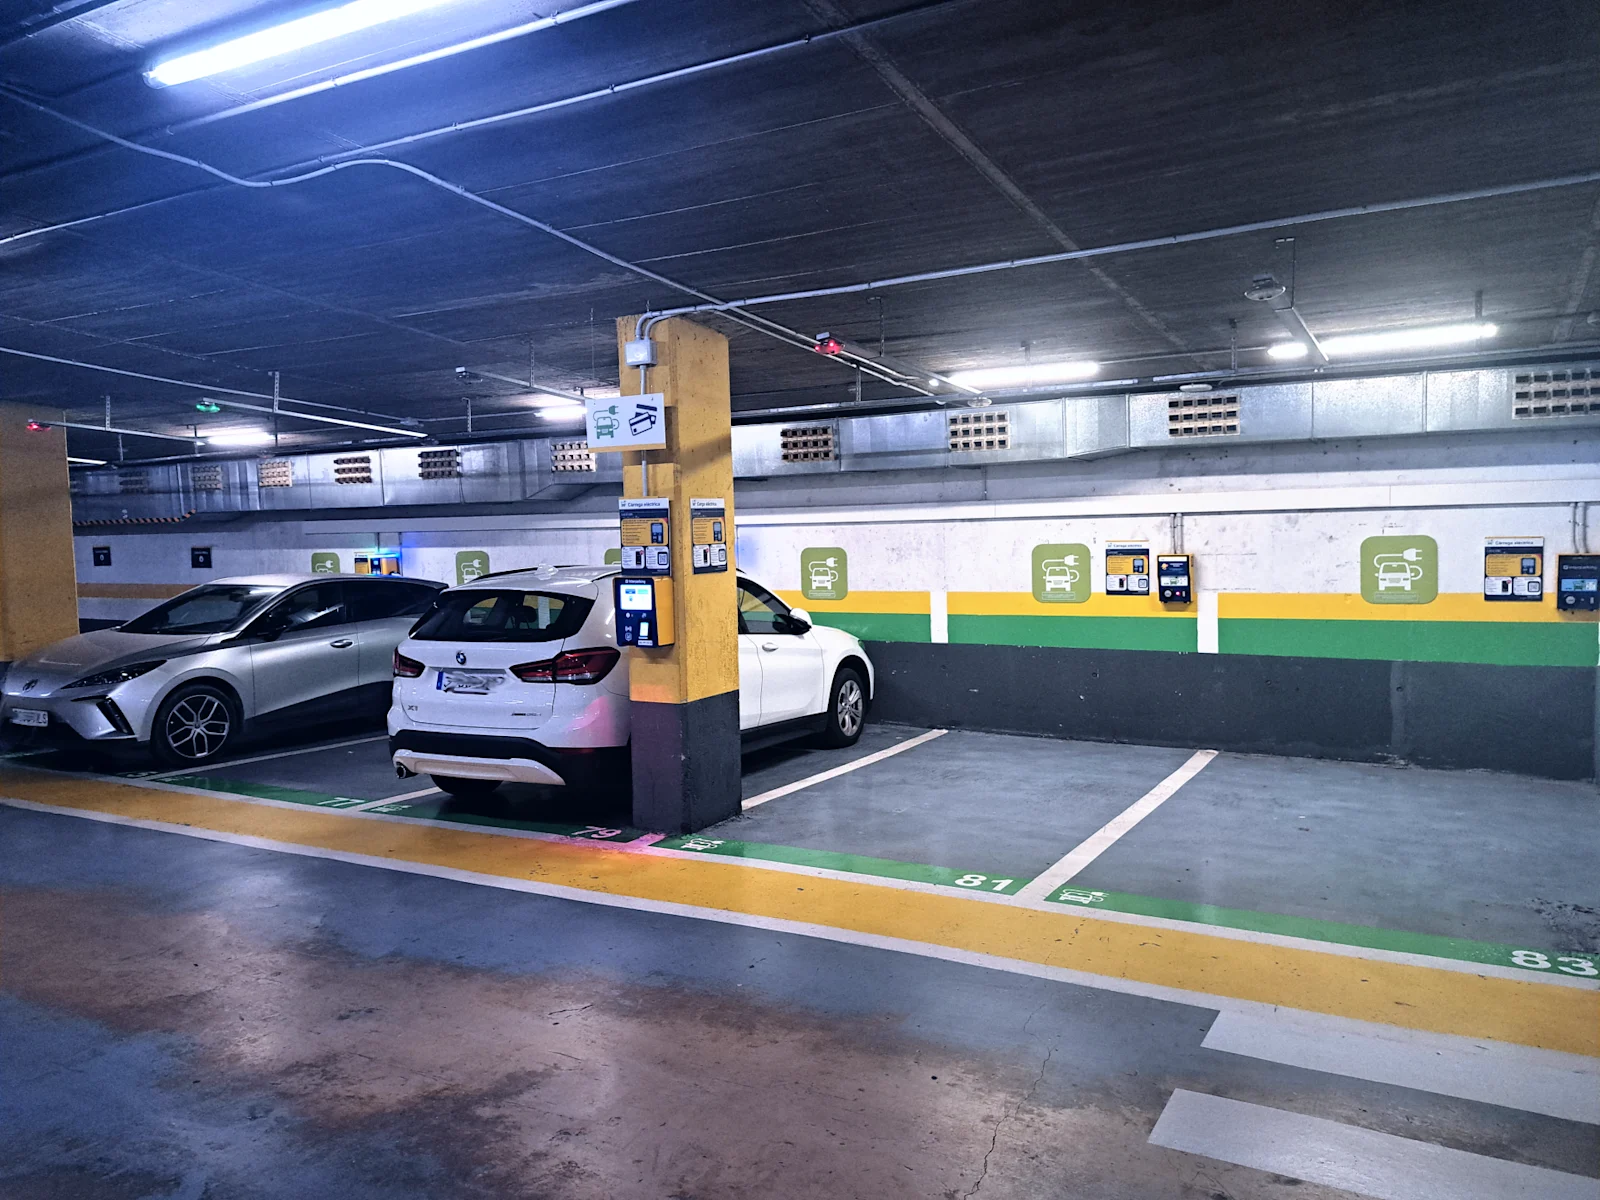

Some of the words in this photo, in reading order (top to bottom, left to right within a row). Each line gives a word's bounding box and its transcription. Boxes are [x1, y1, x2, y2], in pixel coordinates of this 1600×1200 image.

[317, 797, 365, 807] 77
[571, 825, 622, 838] 79
[954, 874, 1014, 891] 81
[1511, 950, 1598, 976] 83
